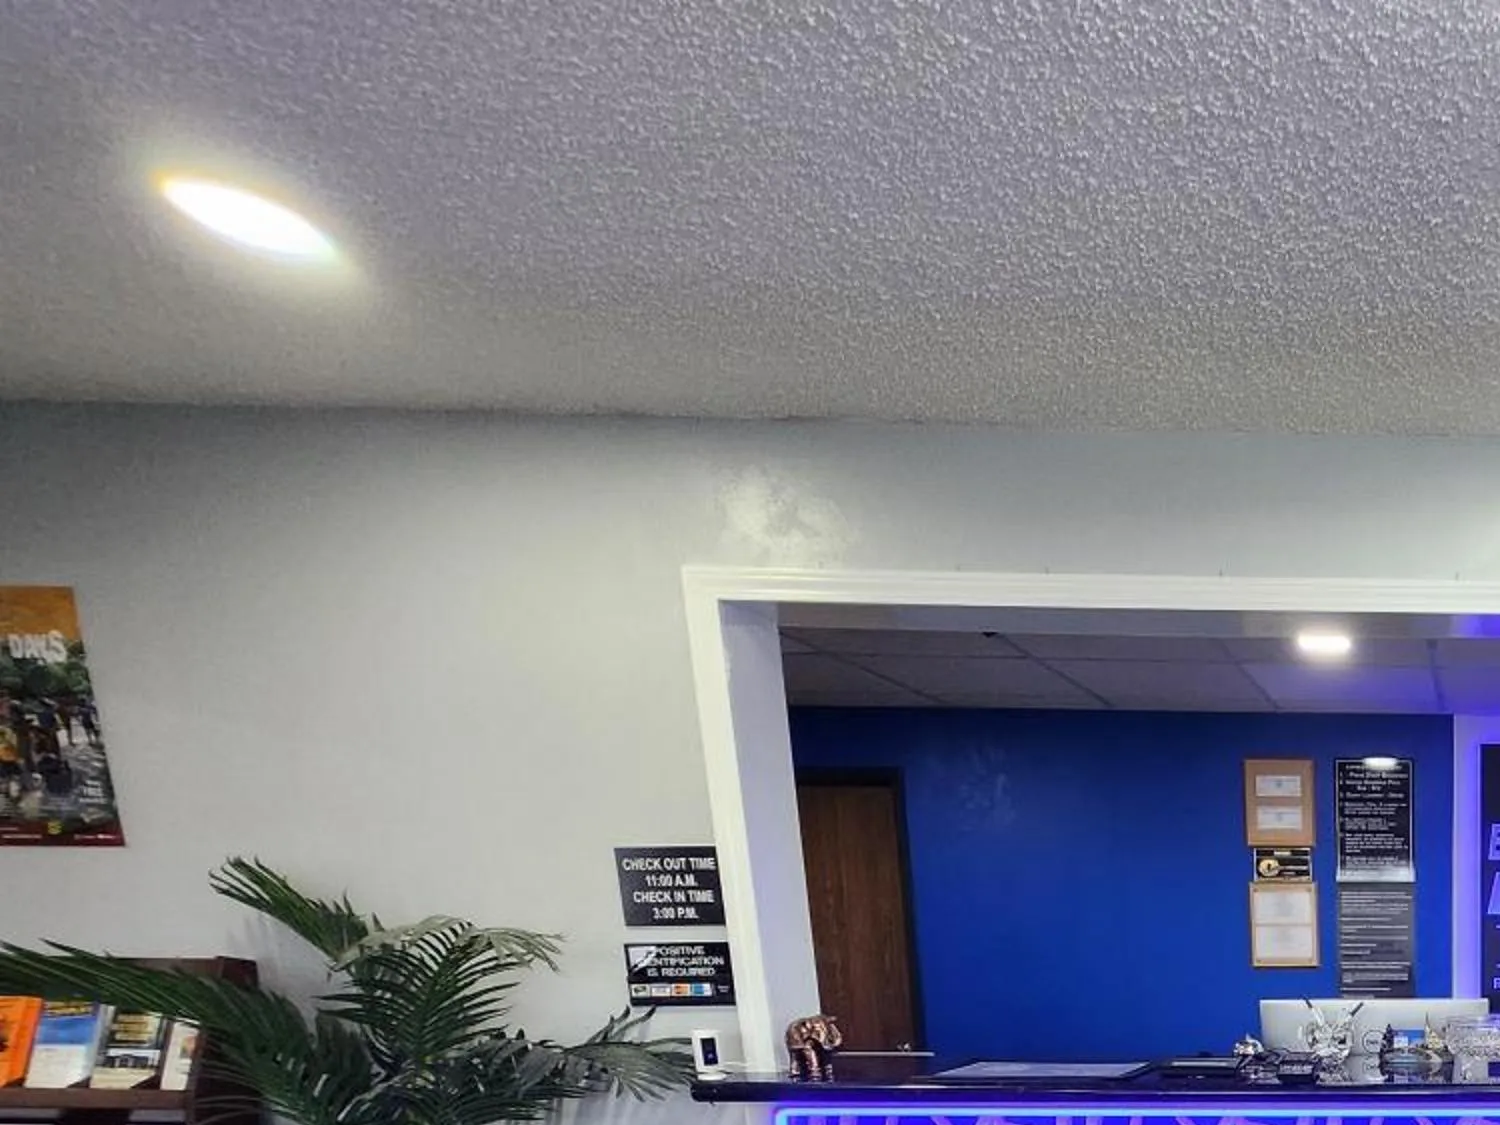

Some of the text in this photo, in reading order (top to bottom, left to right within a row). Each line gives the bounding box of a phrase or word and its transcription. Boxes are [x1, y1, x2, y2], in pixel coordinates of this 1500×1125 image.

[622, 857, 717, 871] CHECK OUT TIME
[645, 874, 672, 887] 11:00
[633, 890, 715, 903] CHECK IN TIME
[656, 945, 705, 955] OSITIVE
